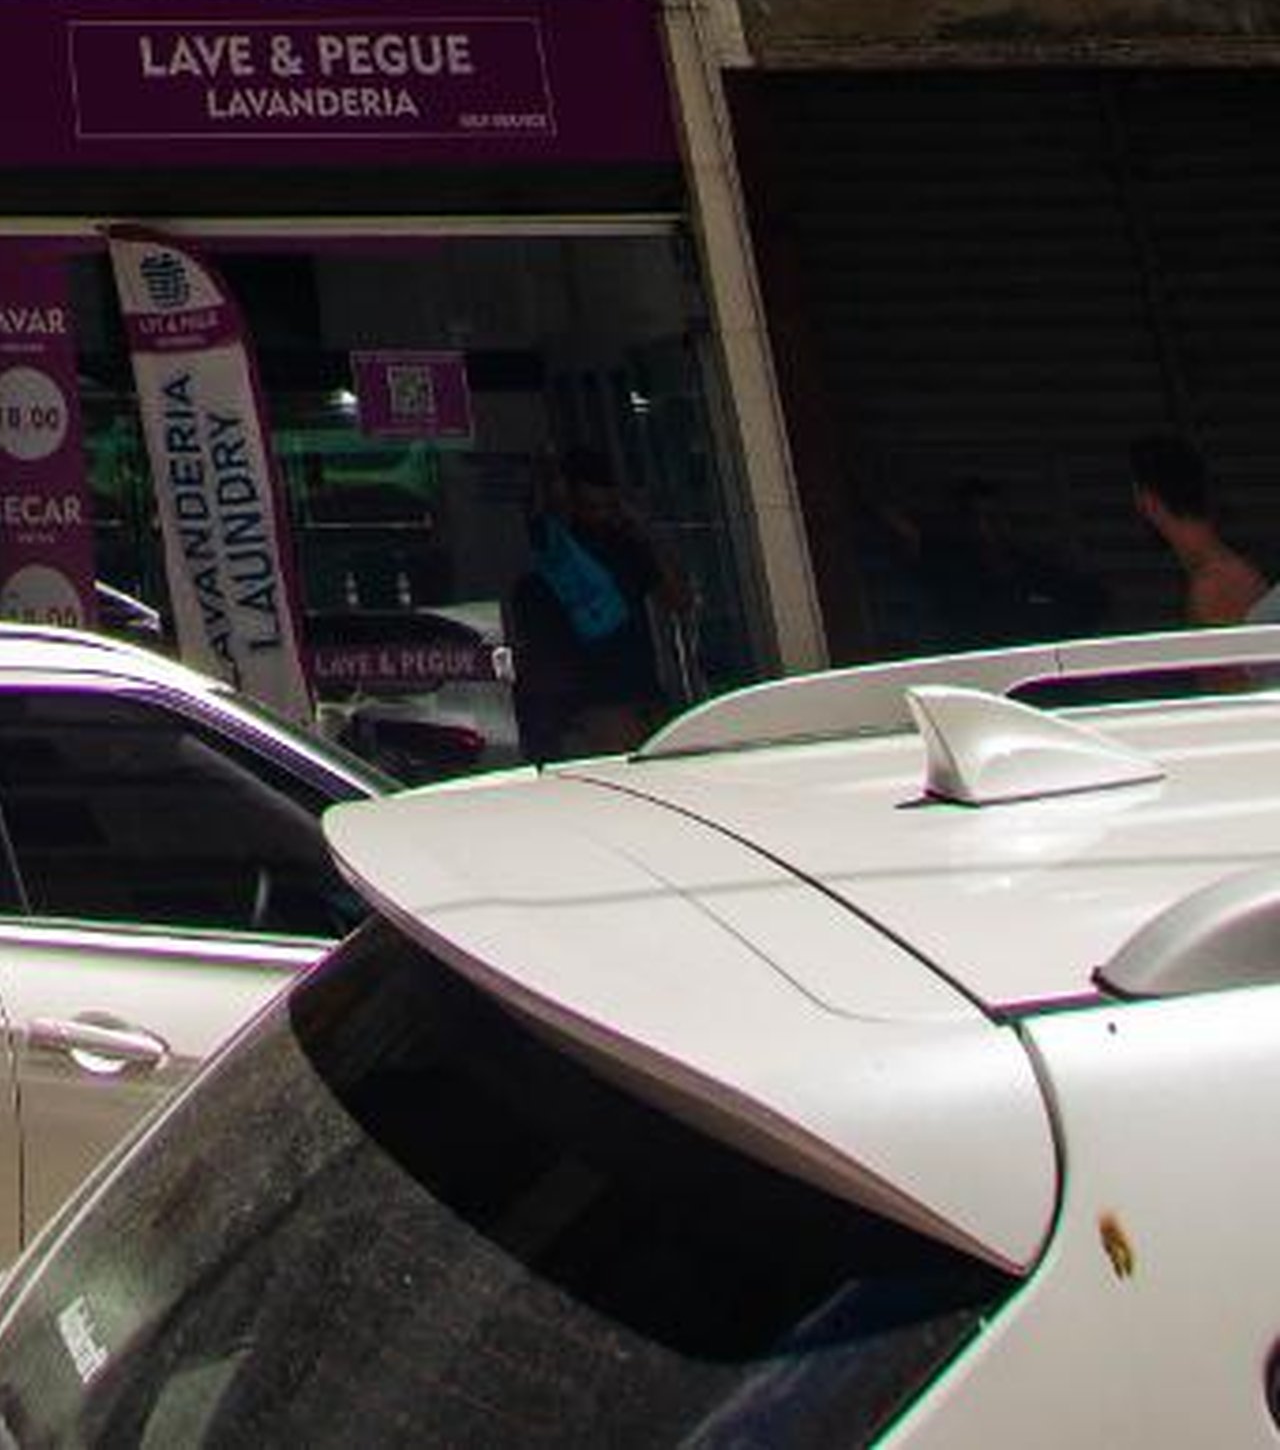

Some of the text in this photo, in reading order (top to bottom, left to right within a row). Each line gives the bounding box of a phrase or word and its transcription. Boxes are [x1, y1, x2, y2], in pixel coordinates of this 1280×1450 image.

[141, 34, 475, 79] LAVE & PEGUE
[206, 87, 420, 119] LAVANDERIA
[208, 413, 282, 651] LAUNDRY
